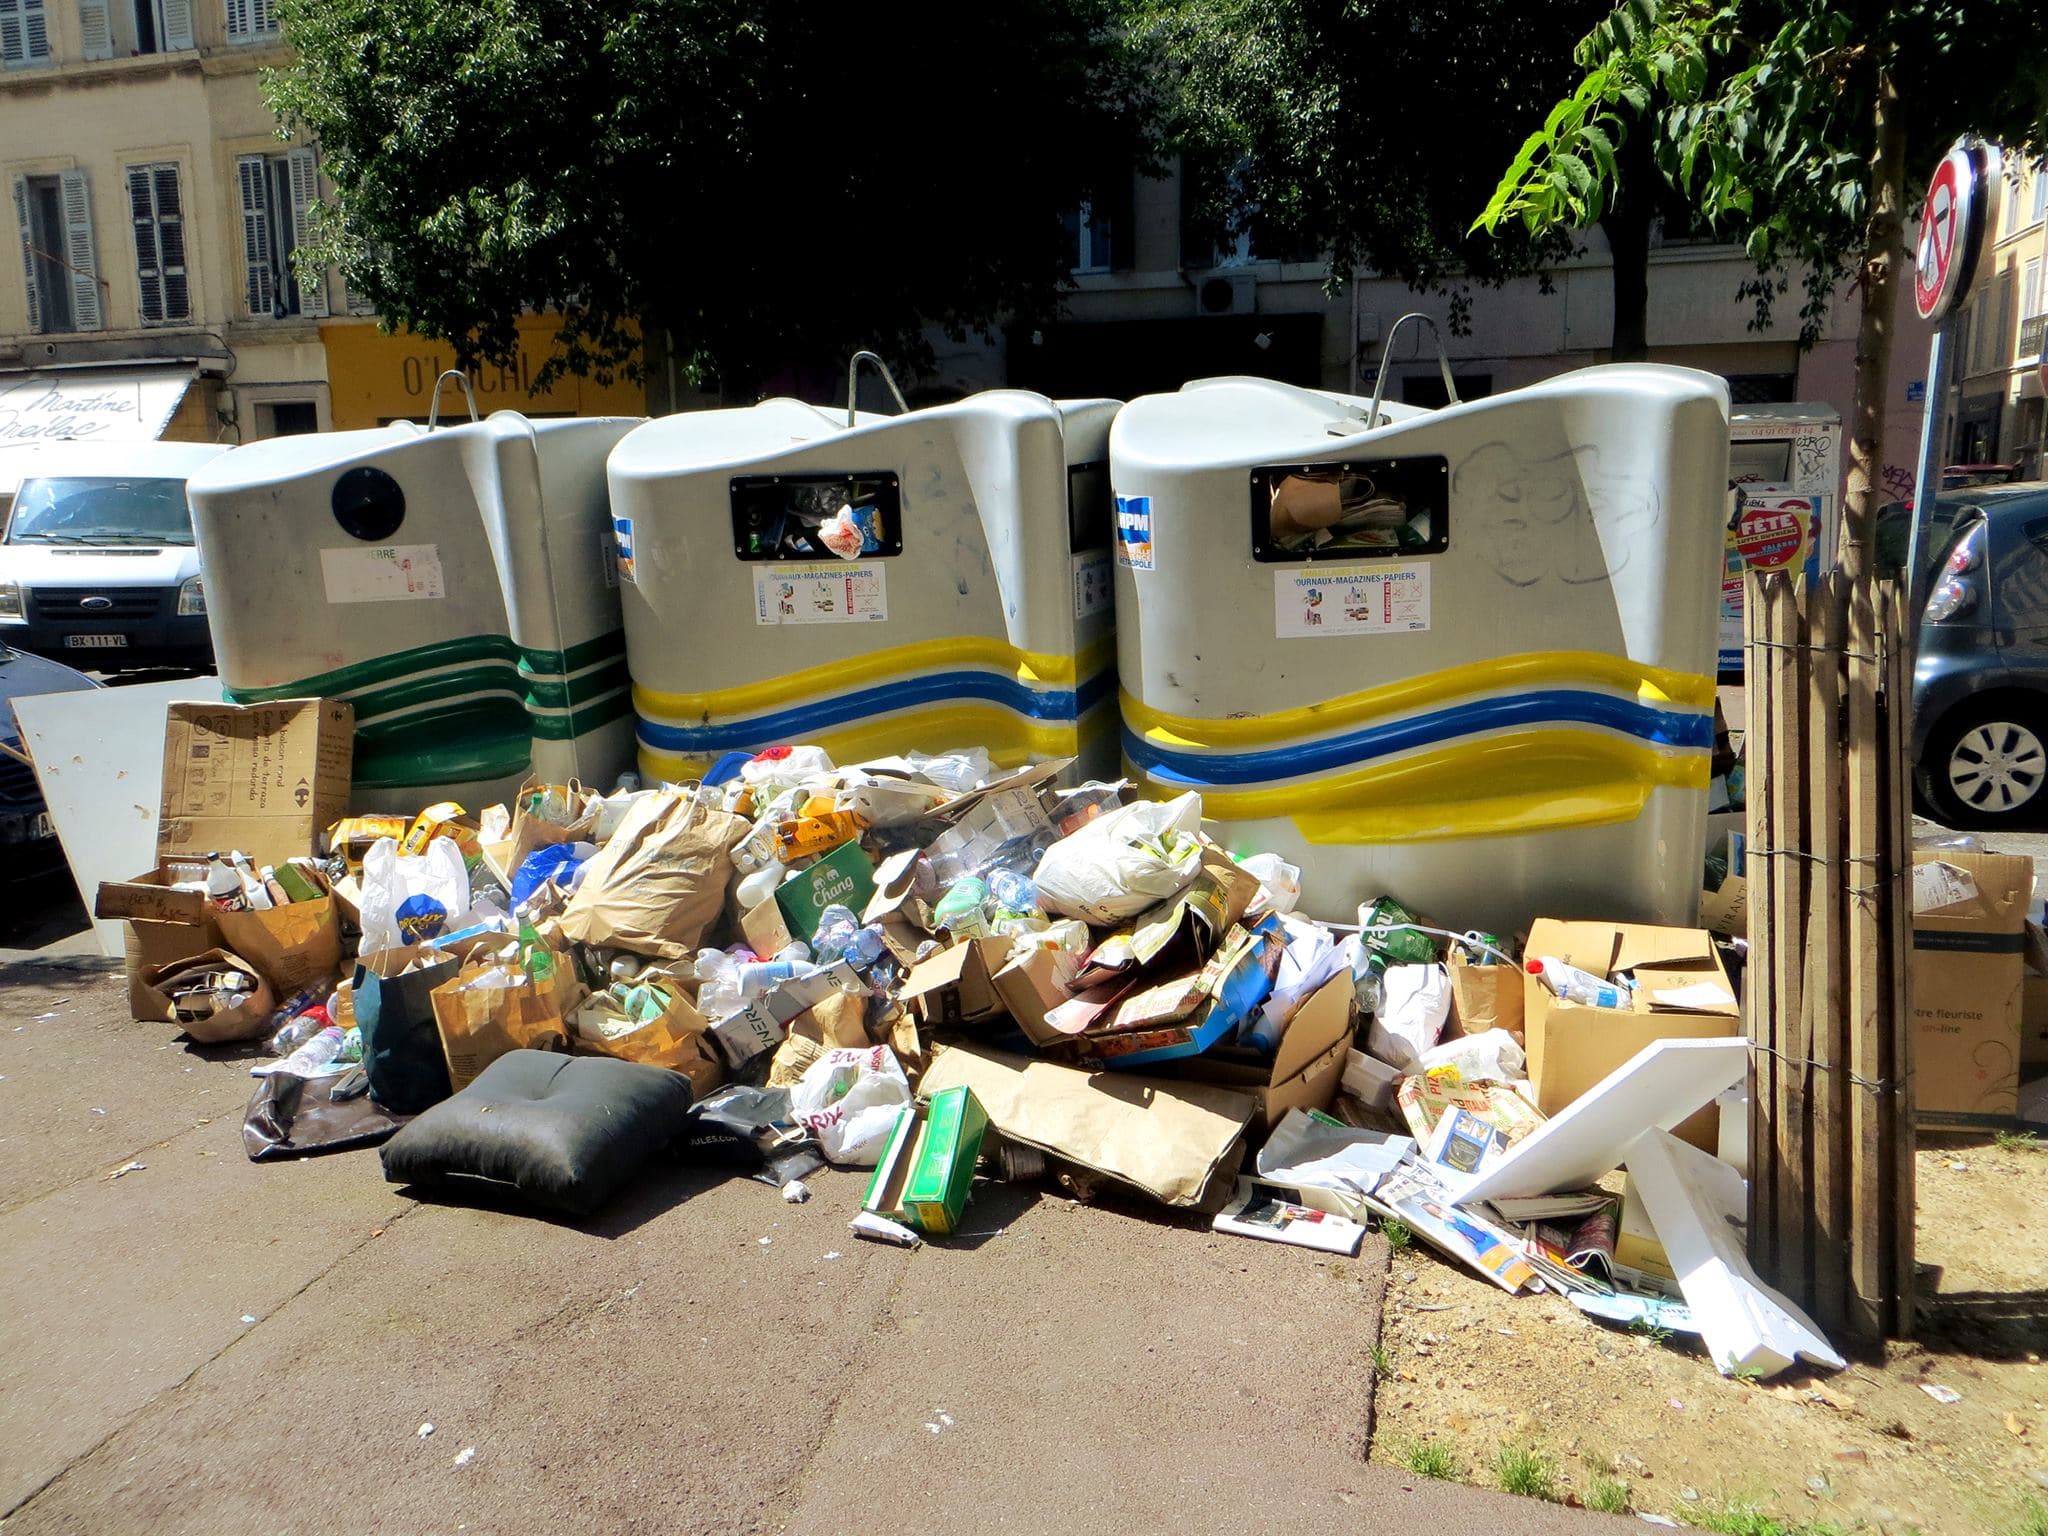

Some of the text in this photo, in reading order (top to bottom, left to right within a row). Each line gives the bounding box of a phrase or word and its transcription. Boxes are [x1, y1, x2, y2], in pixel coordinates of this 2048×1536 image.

[24, 379, 136, 412] Martine
[1741, 513, 1794, 536] FÊTE
[368, 549, 396, 561] ERRE
[769, 570, 874, 581] OURNAUX-MAGAZINES-PAPIERS
[1294, 572, 1417, 587] OURNAUX-MAGAZINES-PAPIERS
[278, 729, 288, 761] balcon
[249, 762, 259, 801] redonda
[813, 876, 855, 908] Chang
[1914, 1008, 1984, 1020] tre fleuriste
[1921, 1024, 1962, 1034] on-line
